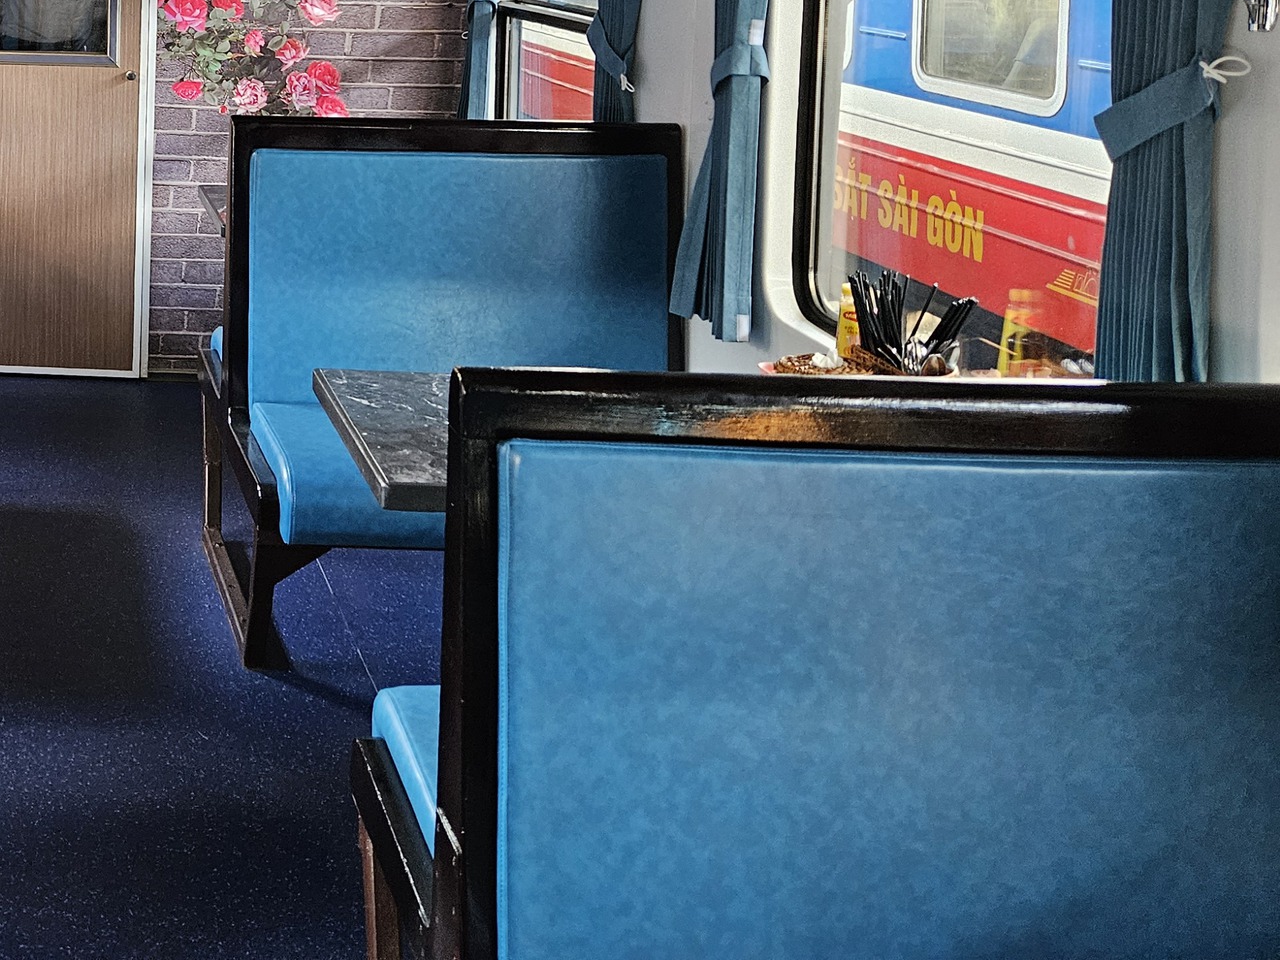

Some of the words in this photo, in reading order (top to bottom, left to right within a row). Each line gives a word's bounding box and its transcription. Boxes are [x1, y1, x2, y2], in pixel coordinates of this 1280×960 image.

[834, 157, 871, 220] SẮT
[878, 174, 919, 239] SÀI
[926, 189, 984, 263] GÒN
